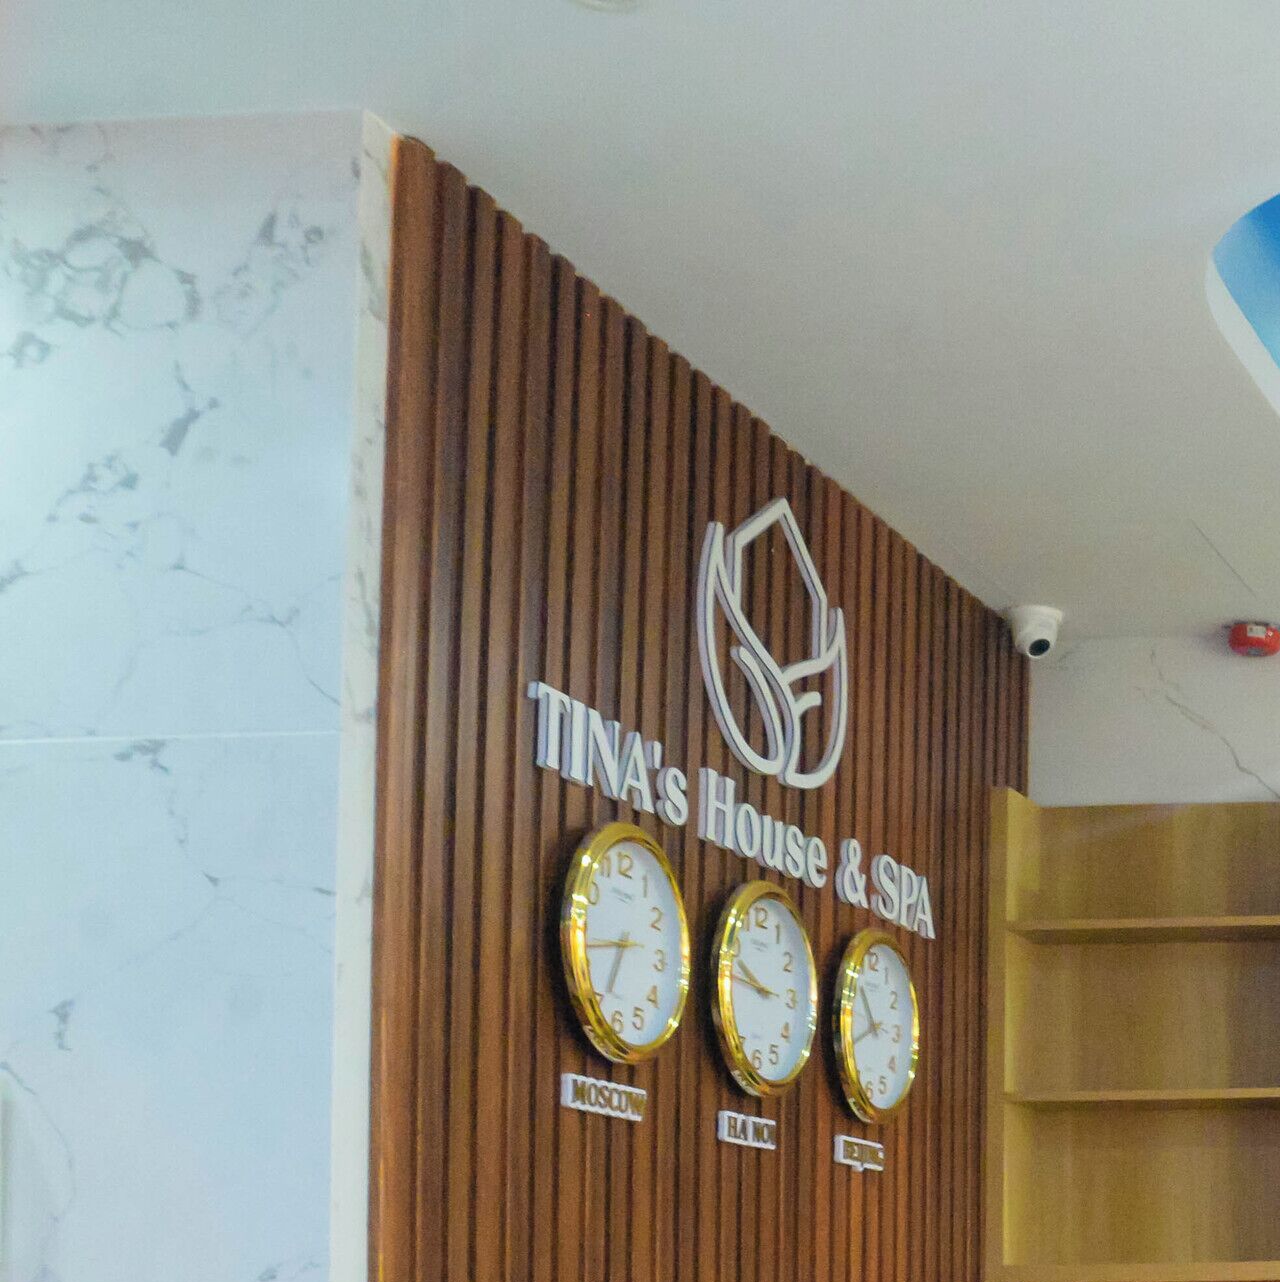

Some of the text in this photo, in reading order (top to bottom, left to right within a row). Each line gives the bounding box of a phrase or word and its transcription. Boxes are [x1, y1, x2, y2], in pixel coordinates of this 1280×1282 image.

[527, 680, 936, 940] TINA's House & SPA
[650, 907, 663, 931] 2
[653, 950, 667, 972] 3
[783, 952, 793, 972] 2
[647, 986, 659, 1008] 4
[786, 988, 797, 1010] 3
[889, 991, 898, 1010] 2
[611, 1010, 624, 1035] 6
[632, 1006, 644, 1031] 5
[752, 1049, 762, 1070] 6
[769, 1044, 779, 1065] 5
[877, 1076, 887, 1095] 5
[571, 1078, 646, 1117] MOSCOW
